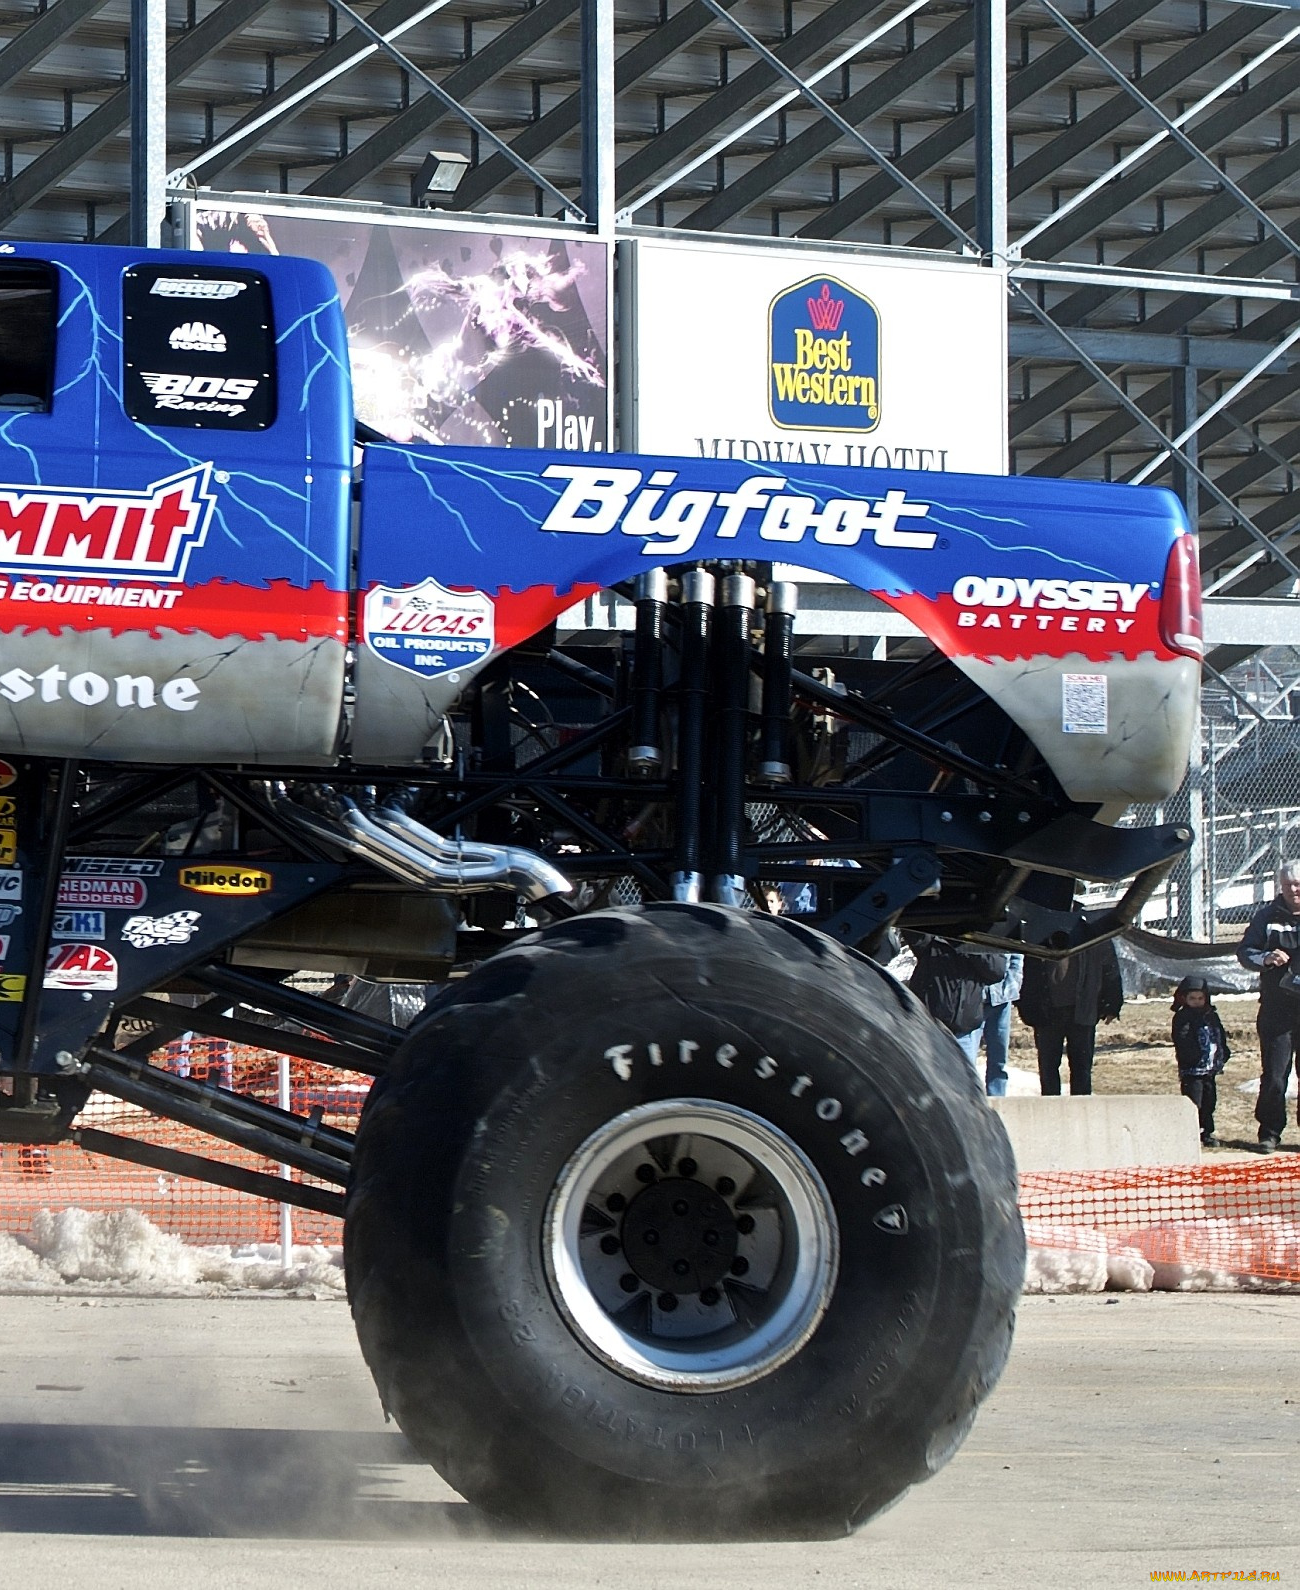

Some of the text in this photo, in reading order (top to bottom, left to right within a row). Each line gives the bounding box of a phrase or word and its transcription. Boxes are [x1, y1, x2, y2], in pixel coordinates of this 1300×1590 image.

[169, 322, 227, 344] MAC
[794, 328, 852, 373] Best
[144, 373, 259, 400] BDS
[773, 362, 876, 407] Western
[155, 395, 247, 417] Racing
[540, 464, 939, 556] Bigfoot
[10, 581, 184, 609] EQUIPMENT
[952, 575, 1149, 613] ODYSSEY
[382, 612, 484, 635] LUCAS
[957, 611, 1135, 634] BATTERY
[373, 636, 487, 653] OIL PRODUCTS
[414, 654, 447, 667] INC.
[59, 877, 135, 893] HEDMAN
[184, 871, 267, 888] Milodon
[57, 893, 136, 905] HEDDERS
[75, 912, 103, 933] K1
[123, 916, 192, 941] FASS
[604, 1039, 887, 1188] Firestone
